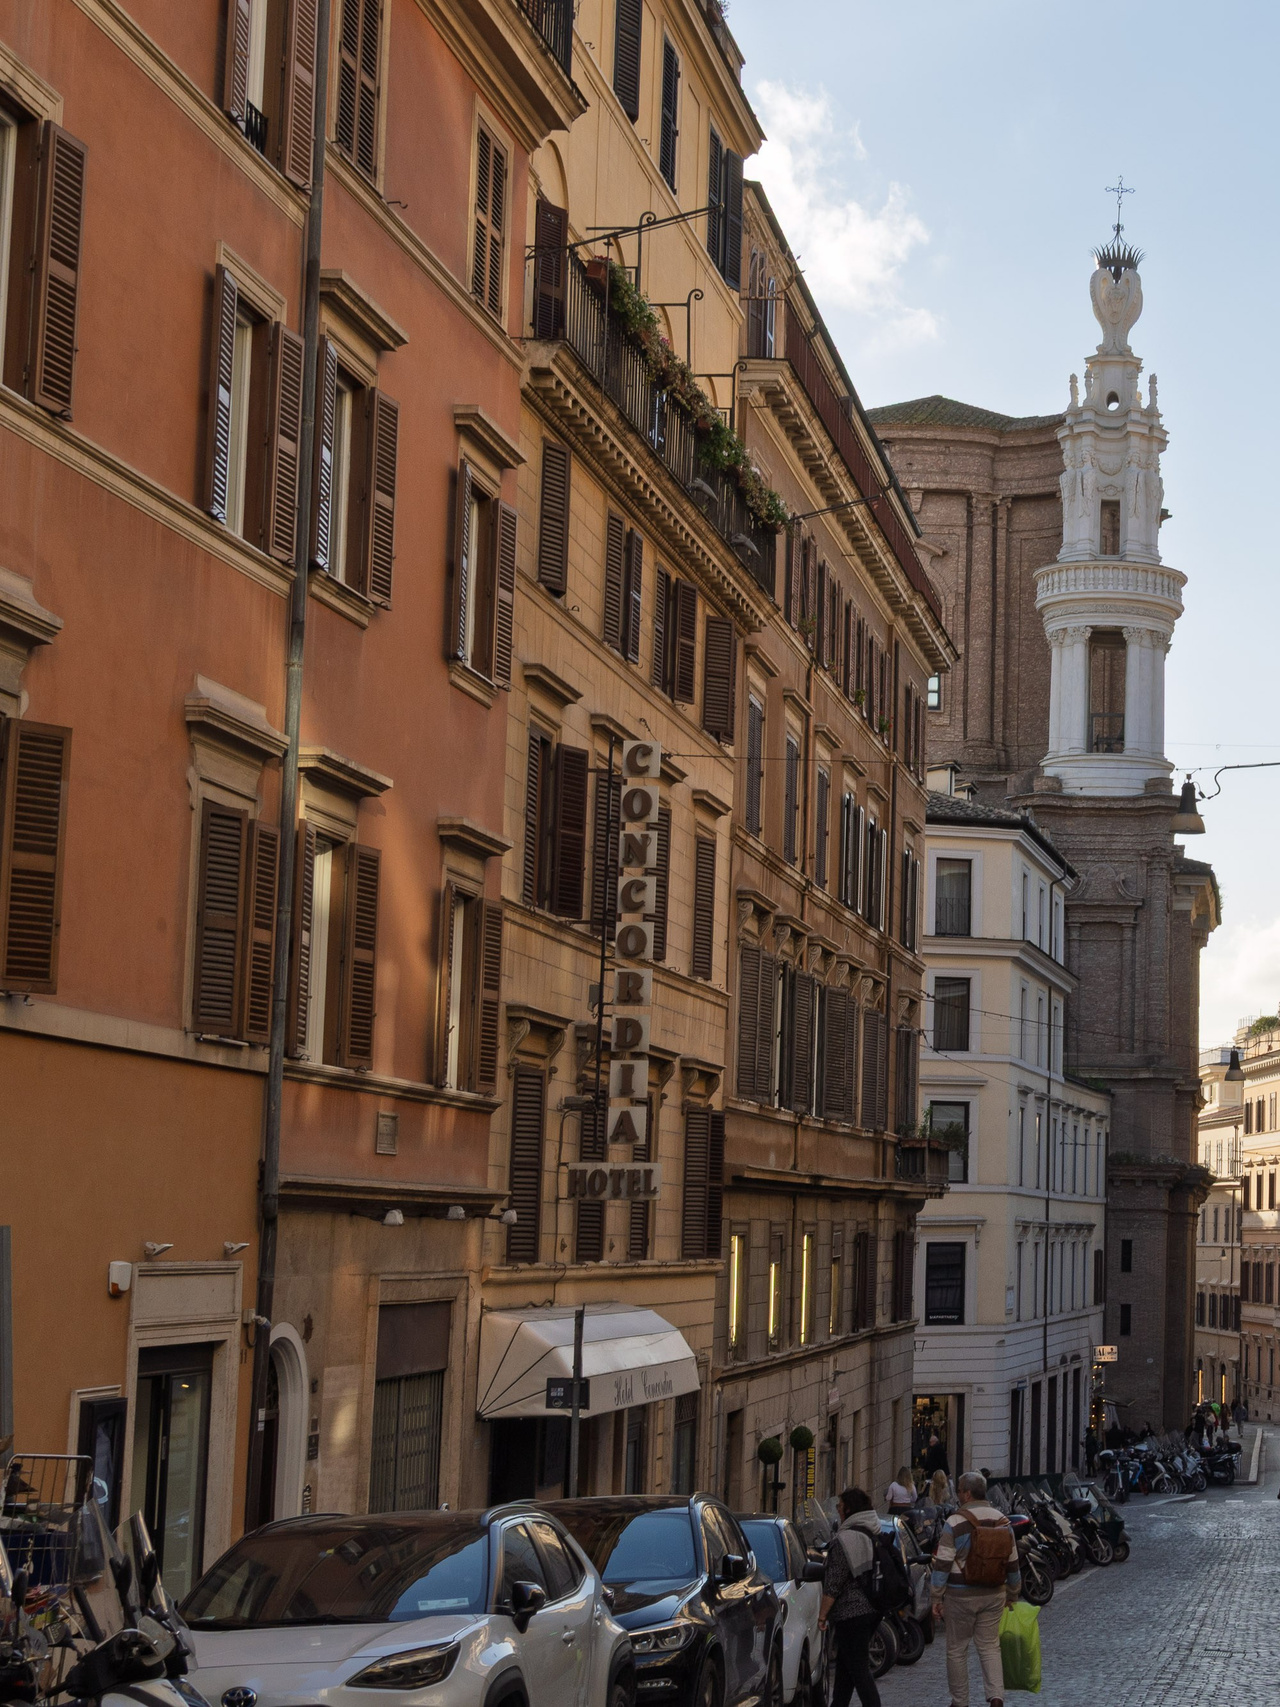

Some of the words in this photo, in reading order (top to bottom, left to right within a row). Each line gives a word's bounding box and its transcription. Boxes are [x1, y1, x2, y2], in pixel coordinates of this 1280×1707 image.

[611, 743, 653, 1141] CONCORDIA
[568, 1167, 658, 1198] HOTEL
[614, 1374, 634, 1406] Hotel
[641, 1370, 673, 1399] Concordia
[807, 1447, 815, 1462] BUY
[807, 1464, 815, 1484] YOUR
